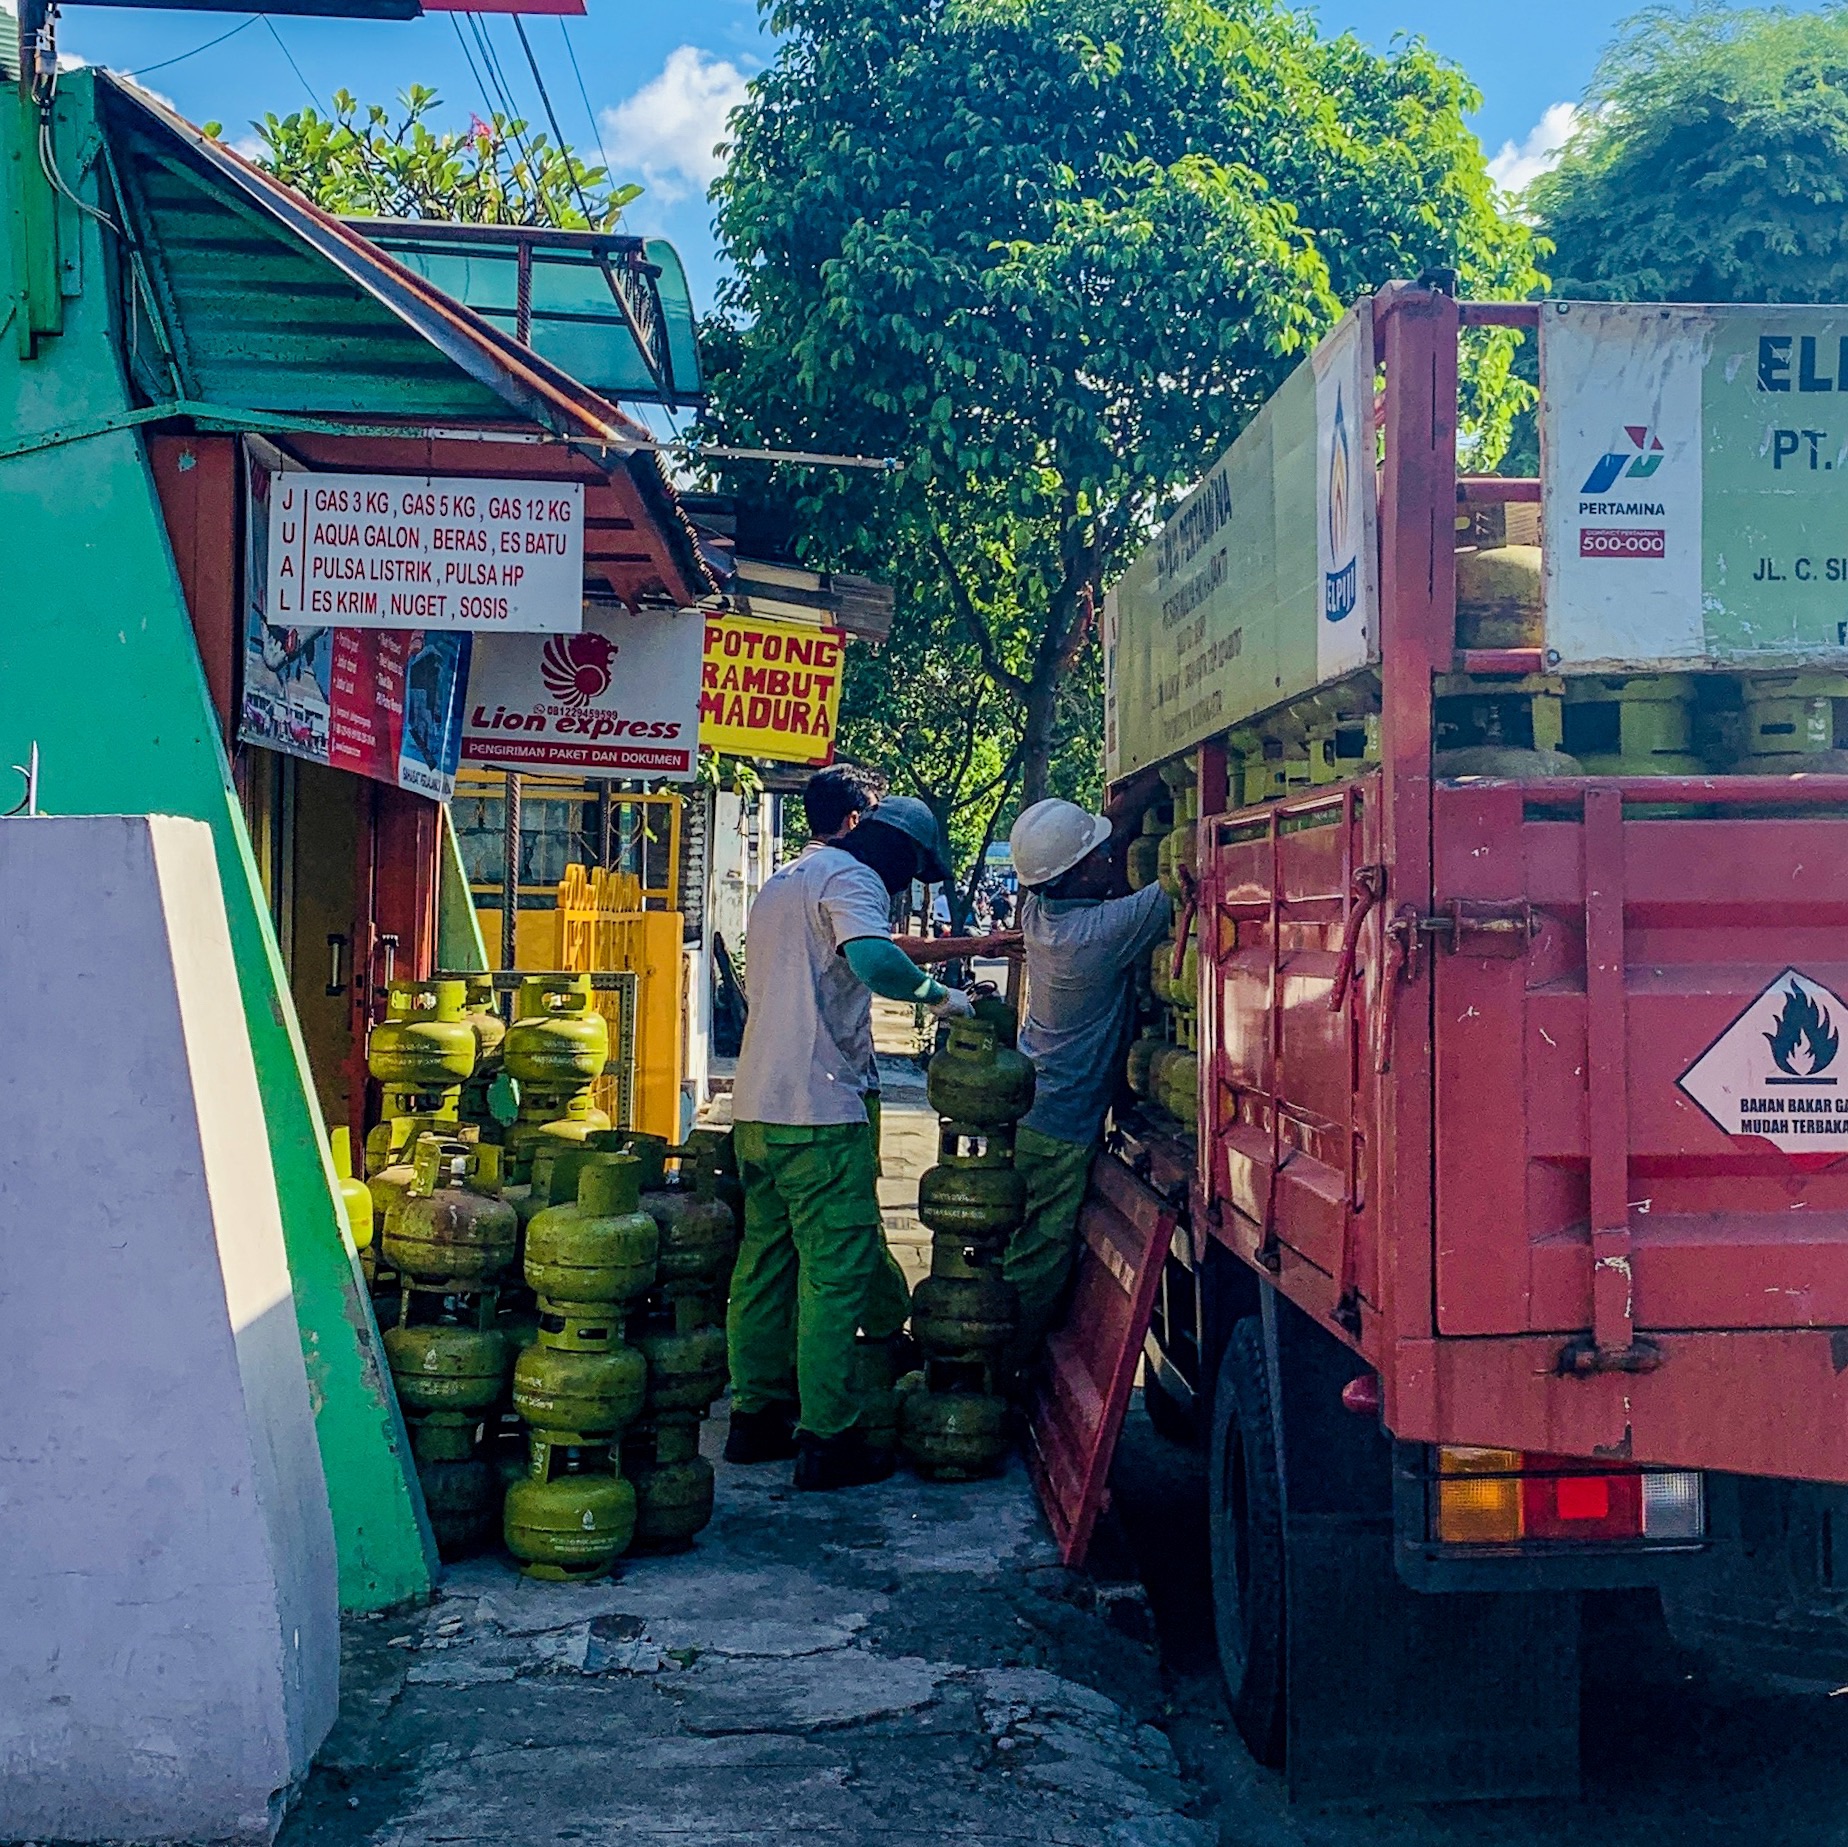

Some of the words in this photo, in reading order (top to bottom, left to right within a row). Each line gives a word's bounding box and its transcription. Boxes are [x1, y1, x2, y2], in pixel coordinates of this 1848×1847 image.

[1773, 430, 1832, 470] PT.
[315, 489, 348, 512] GAS
[352, 491, 361, 513] 3
[402, 493, 435, 516] GAS
[439, 495, 448, 517] 5
[489, 497, 522, 520] GAS
[526, 499, 544, 521] 12
[548, 500, 571, 522] KG
[1579, 502, 1665, 516] PERTAMINA
[314, 523, 359, 547] AQUA
[500, 531, 521, 553] ES
[525, 532, 567, 555] BATU
[1582, 536, 1664, 552] 500-000
[312, 556, 366, 580] PULSA
[445, 562, 498, 586] PULSA
[502, 564, 524, 587] HP
[1753, 558, 1788, 581] JL.
[1795, 558, 1817, 581] C.
[312, 590, 332, 613] ES
[459, 595, 508, 620] SOSIS
[1327, 566, 1355, 613] ELPIJI
[703, 625, 838, 669] POTONG
[701, 661, 835, 702] RAMBUT
[471, 705, 547, 732] Lion
[555, 717, 681, 740] express
[699, 690, 830, 738] MADURA
[469, 743, 546, 758] PENGIRIMAN
[549, 748, 588, 761] PAKET
[592, 751, 618, 762] DAN
[621, 752, 681, 766] DOKUMEN
[1740, 1098, 1784, 1113] BAHAN
[1788, 1098, 1832, 1113] BAKAR
[1741, 1119, 1789, 1134] MUDAH
